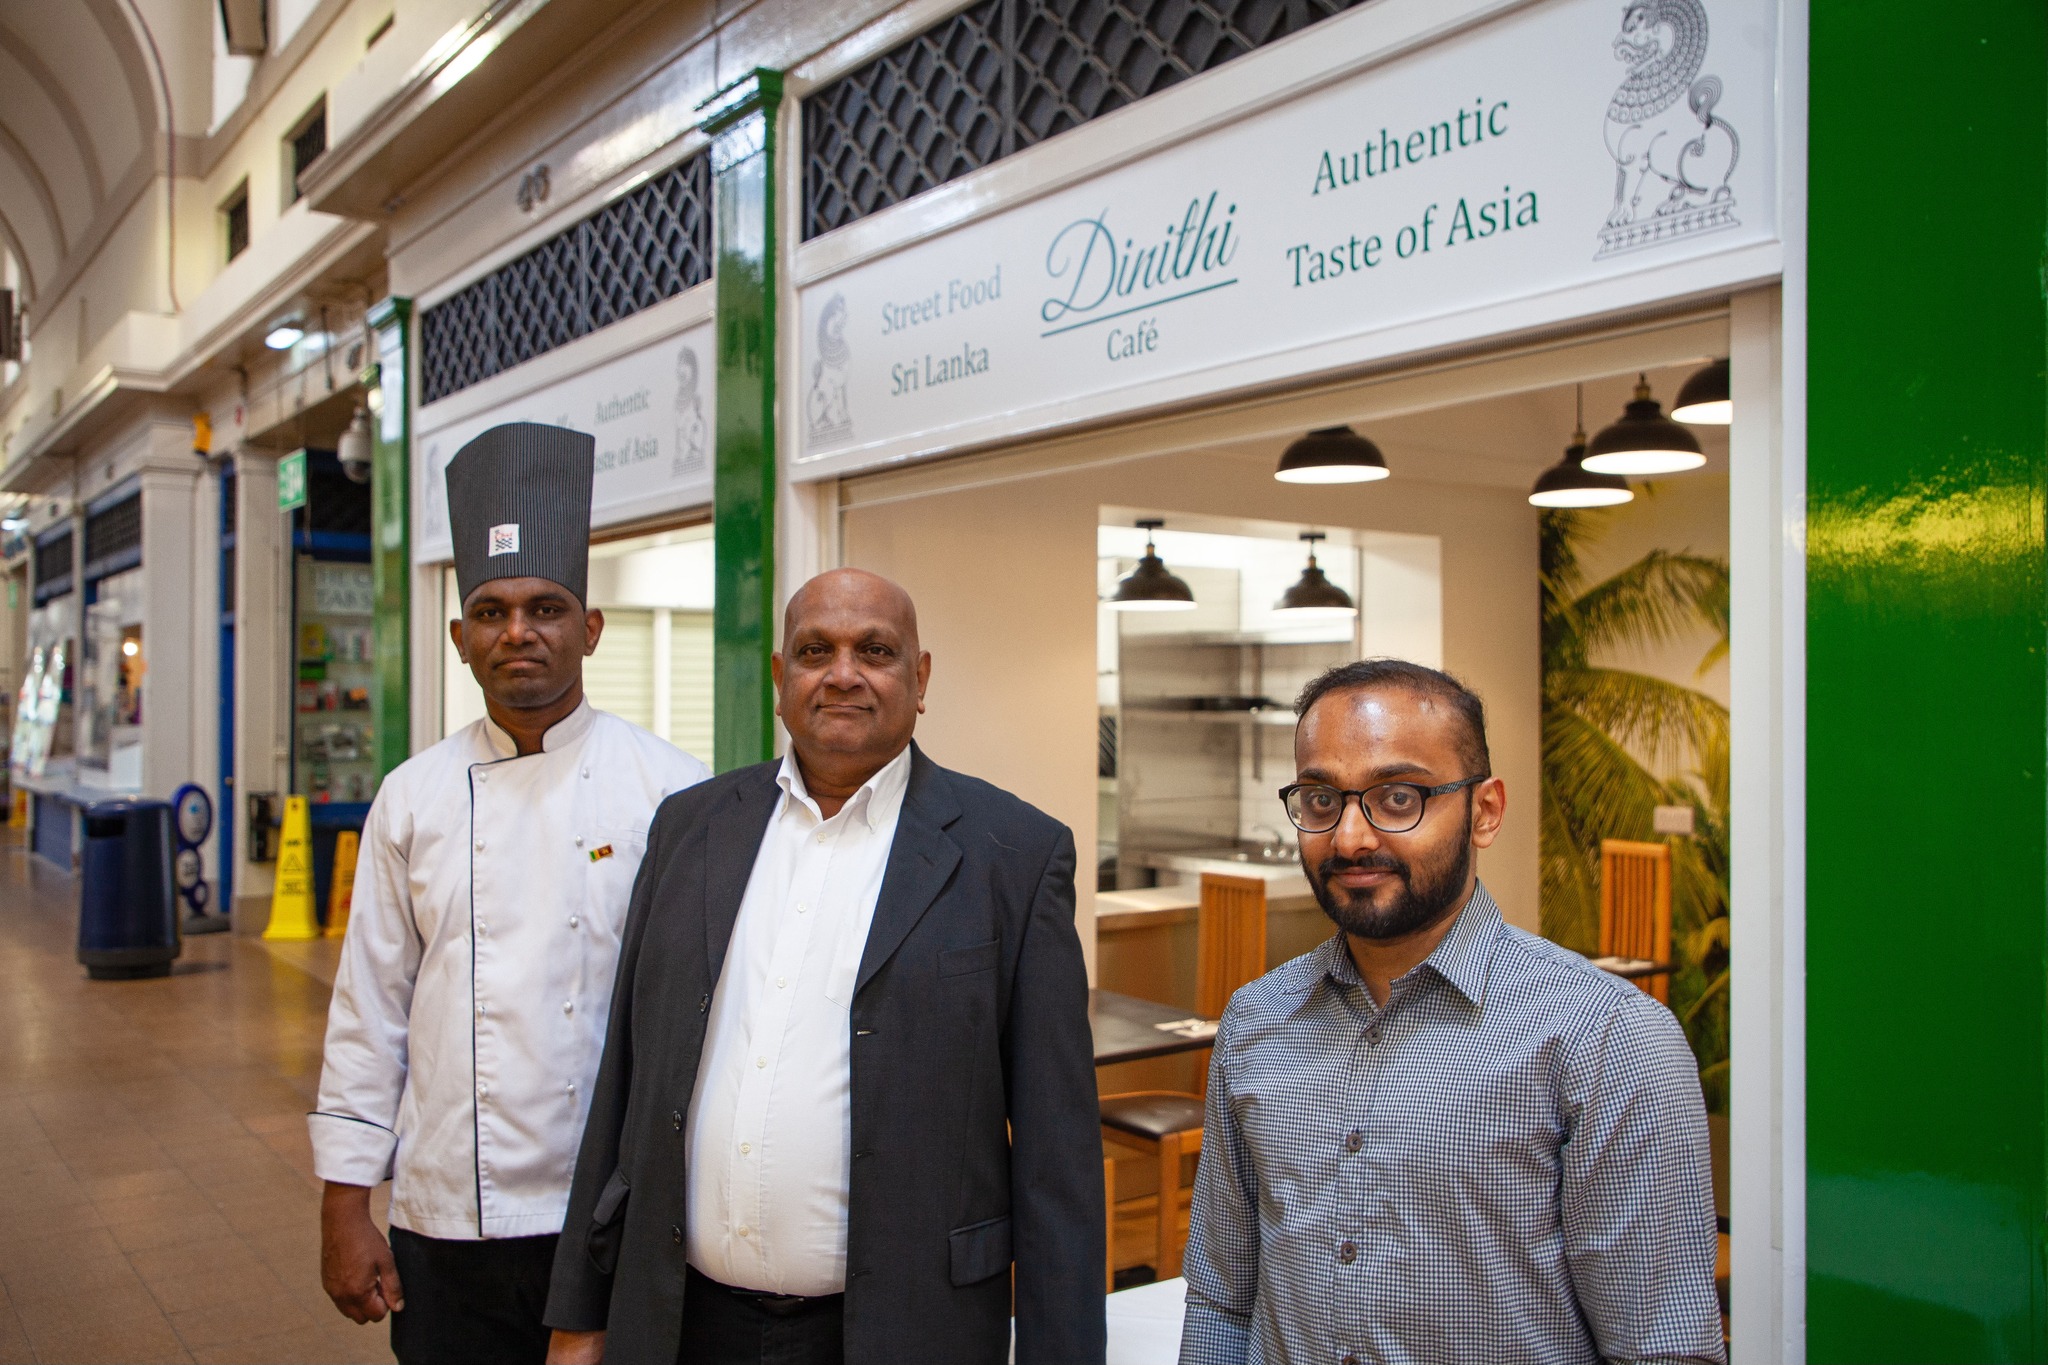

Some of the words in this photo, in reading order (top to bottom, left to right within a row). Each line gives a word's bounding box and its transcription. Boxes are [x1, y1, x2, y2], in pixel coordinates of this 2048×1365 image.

[1311, 97, 1509, 197] Authentic
[1041, 190, 1241, 322] Dinithi
[1286, 233, 1383, 287] Taste
[1395, 203, 1438, 259] of
[1445, 185, 1540, 247] Asia
[881, 291, 942, 335] Street
[948, 264, 1002, 314] Food
[891, 358, 920, 396] Sri
[925, 342, 990, 387] Lanka
[1106, 317, 1159, 361] Café
[594, 384, 651, 426] Authentic
[618, 438, 632, 466] of
[633, 434, 659, 463] Asia
